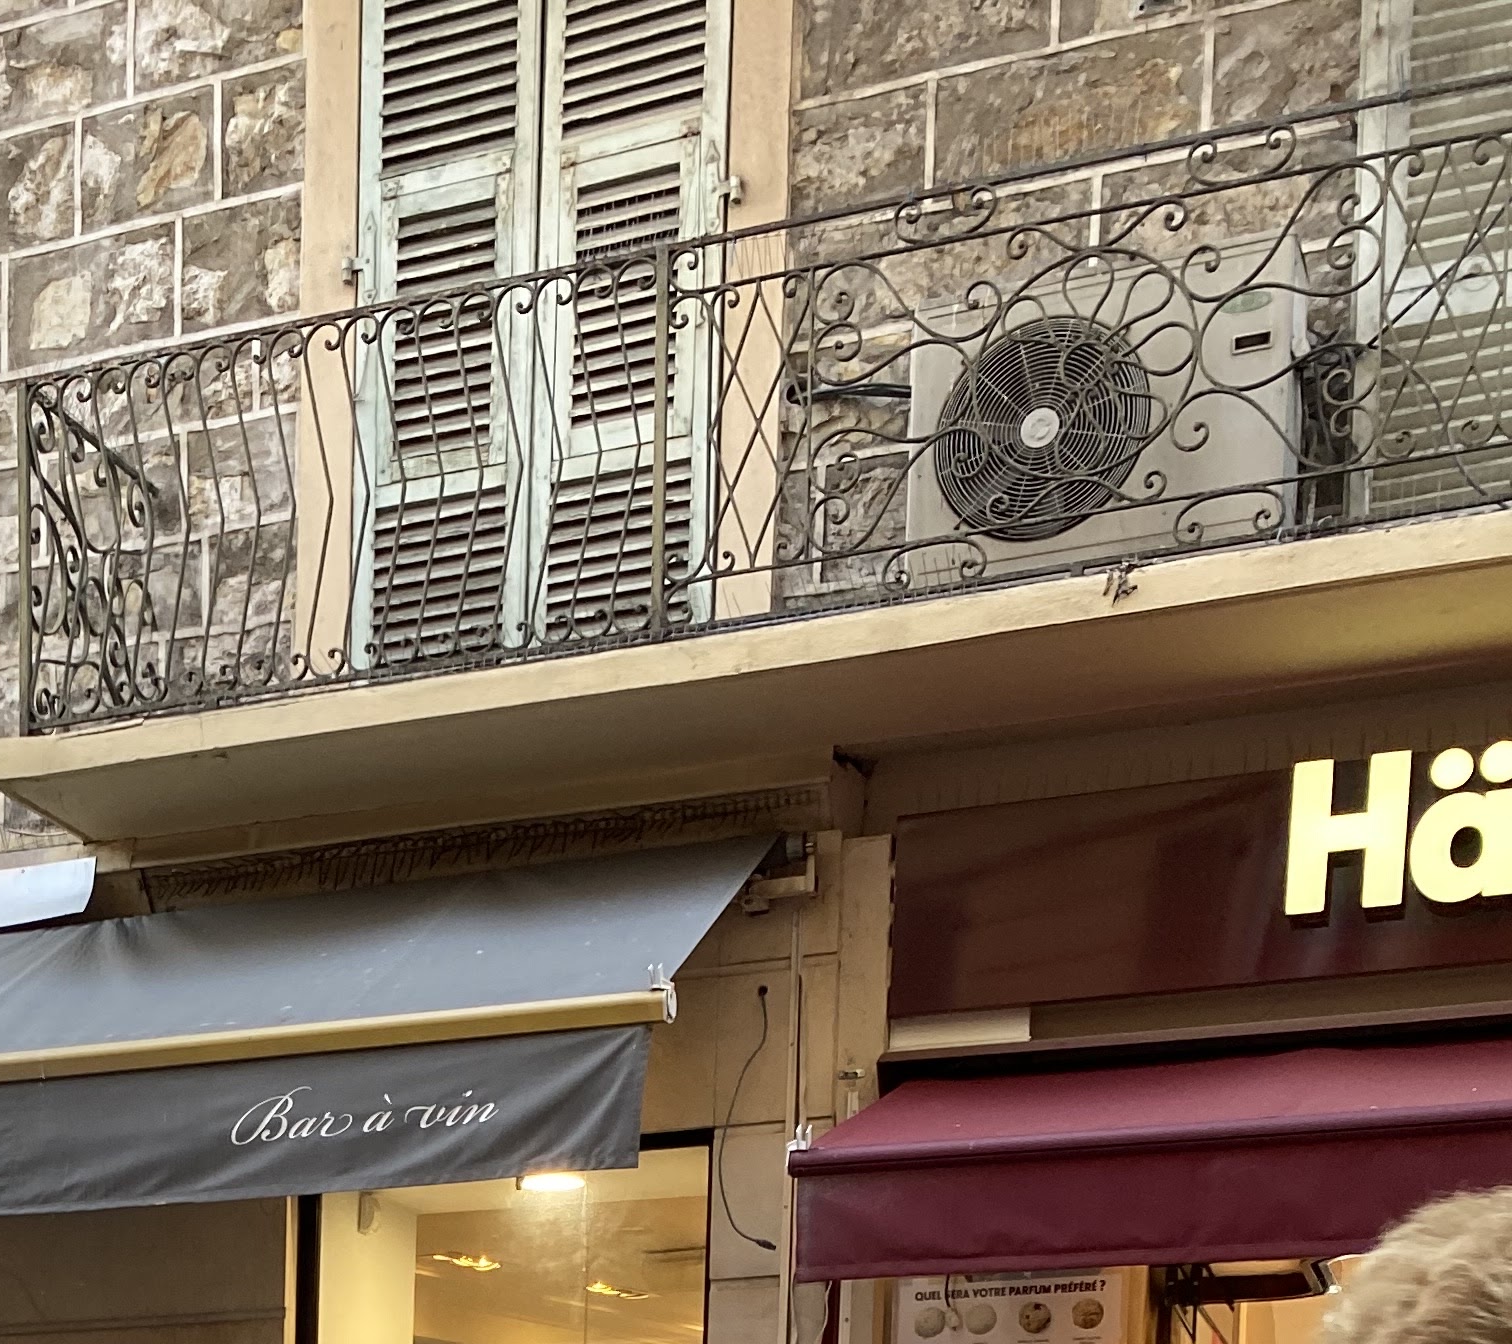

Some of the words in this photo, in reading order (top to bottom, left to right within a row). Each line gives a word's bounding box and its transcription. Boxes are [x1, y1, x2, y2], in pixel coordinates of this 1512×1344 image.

[231, 1086, 352, 1146] Bar
[363, 1093, 394, 1133] à
[405, 1089, 500, 1129] vin
[915, 1290, 942, 1301] QUEL
[972, 1285, 1007, 1298] VOTRE
[1008, 1283, 1052, 1296] PARFUM
[1054, 1280, 1098, 1293] PRÉFÉRÉ
